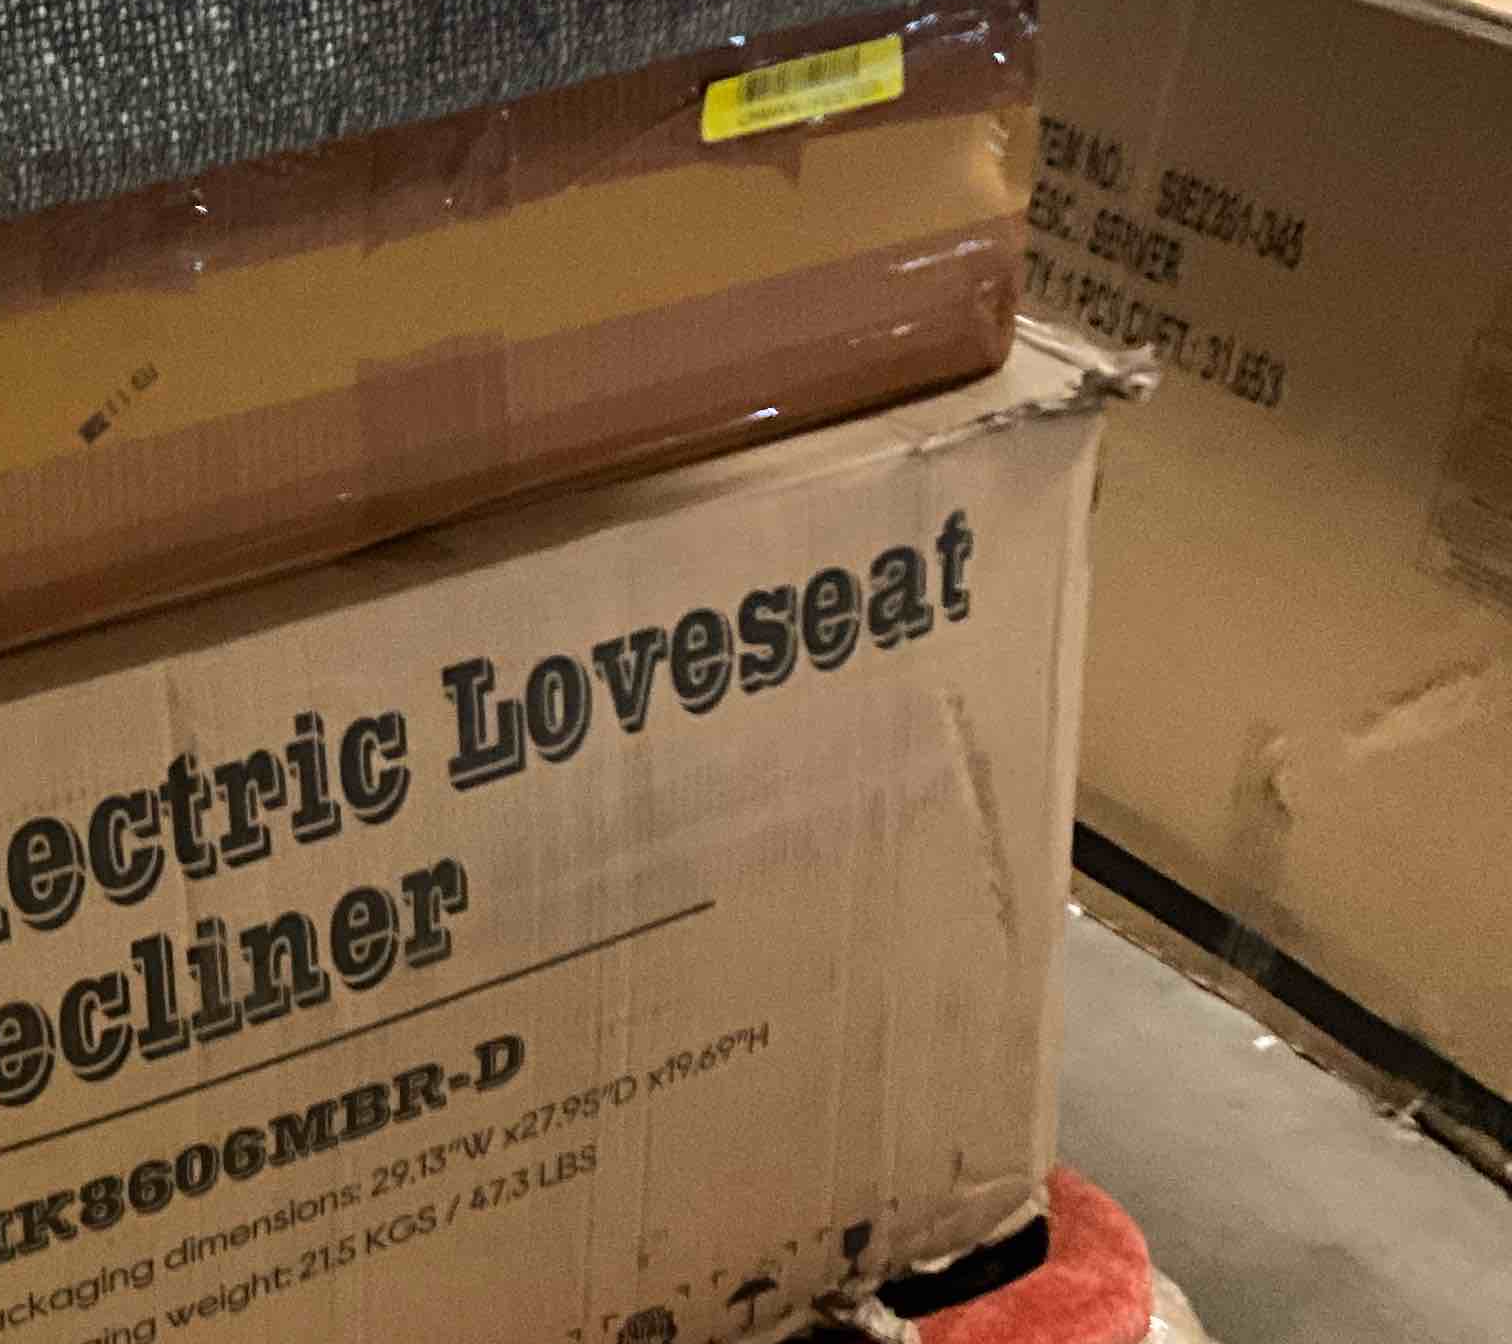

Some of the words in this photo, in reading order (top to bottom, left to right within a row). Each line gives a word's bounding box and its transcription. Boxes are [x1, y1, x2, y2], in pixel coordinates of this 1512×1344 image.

[443, 510, 976, 789] Loveseat
[164, 1182, 362, 1273] dimensions:
[165, 1264, 294, 1338] weight:
[365, 1203, 438, 1251] KGS
[445, 1192, 461, 1227] /
[538, 1143, 600, 1189] LBS
